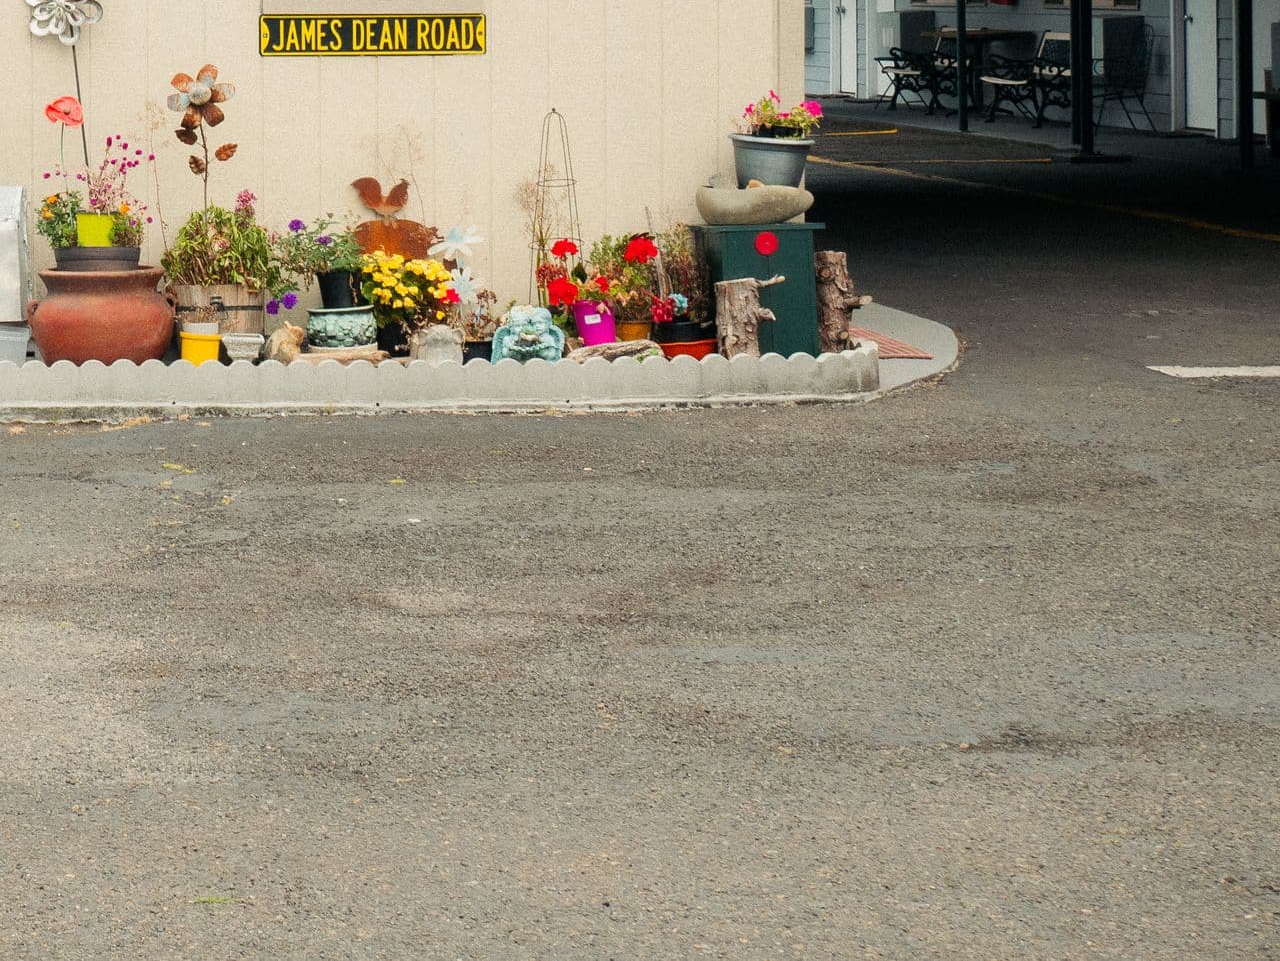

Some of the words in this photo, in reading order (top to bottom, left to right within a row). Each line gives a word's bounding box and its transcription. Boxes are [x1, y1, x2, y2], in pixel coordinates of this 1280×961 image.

[272, 19, 342, 52] JAMES
[352, 19, 408, 51] DEAN
[417, 18, 475, 51] ROAD
